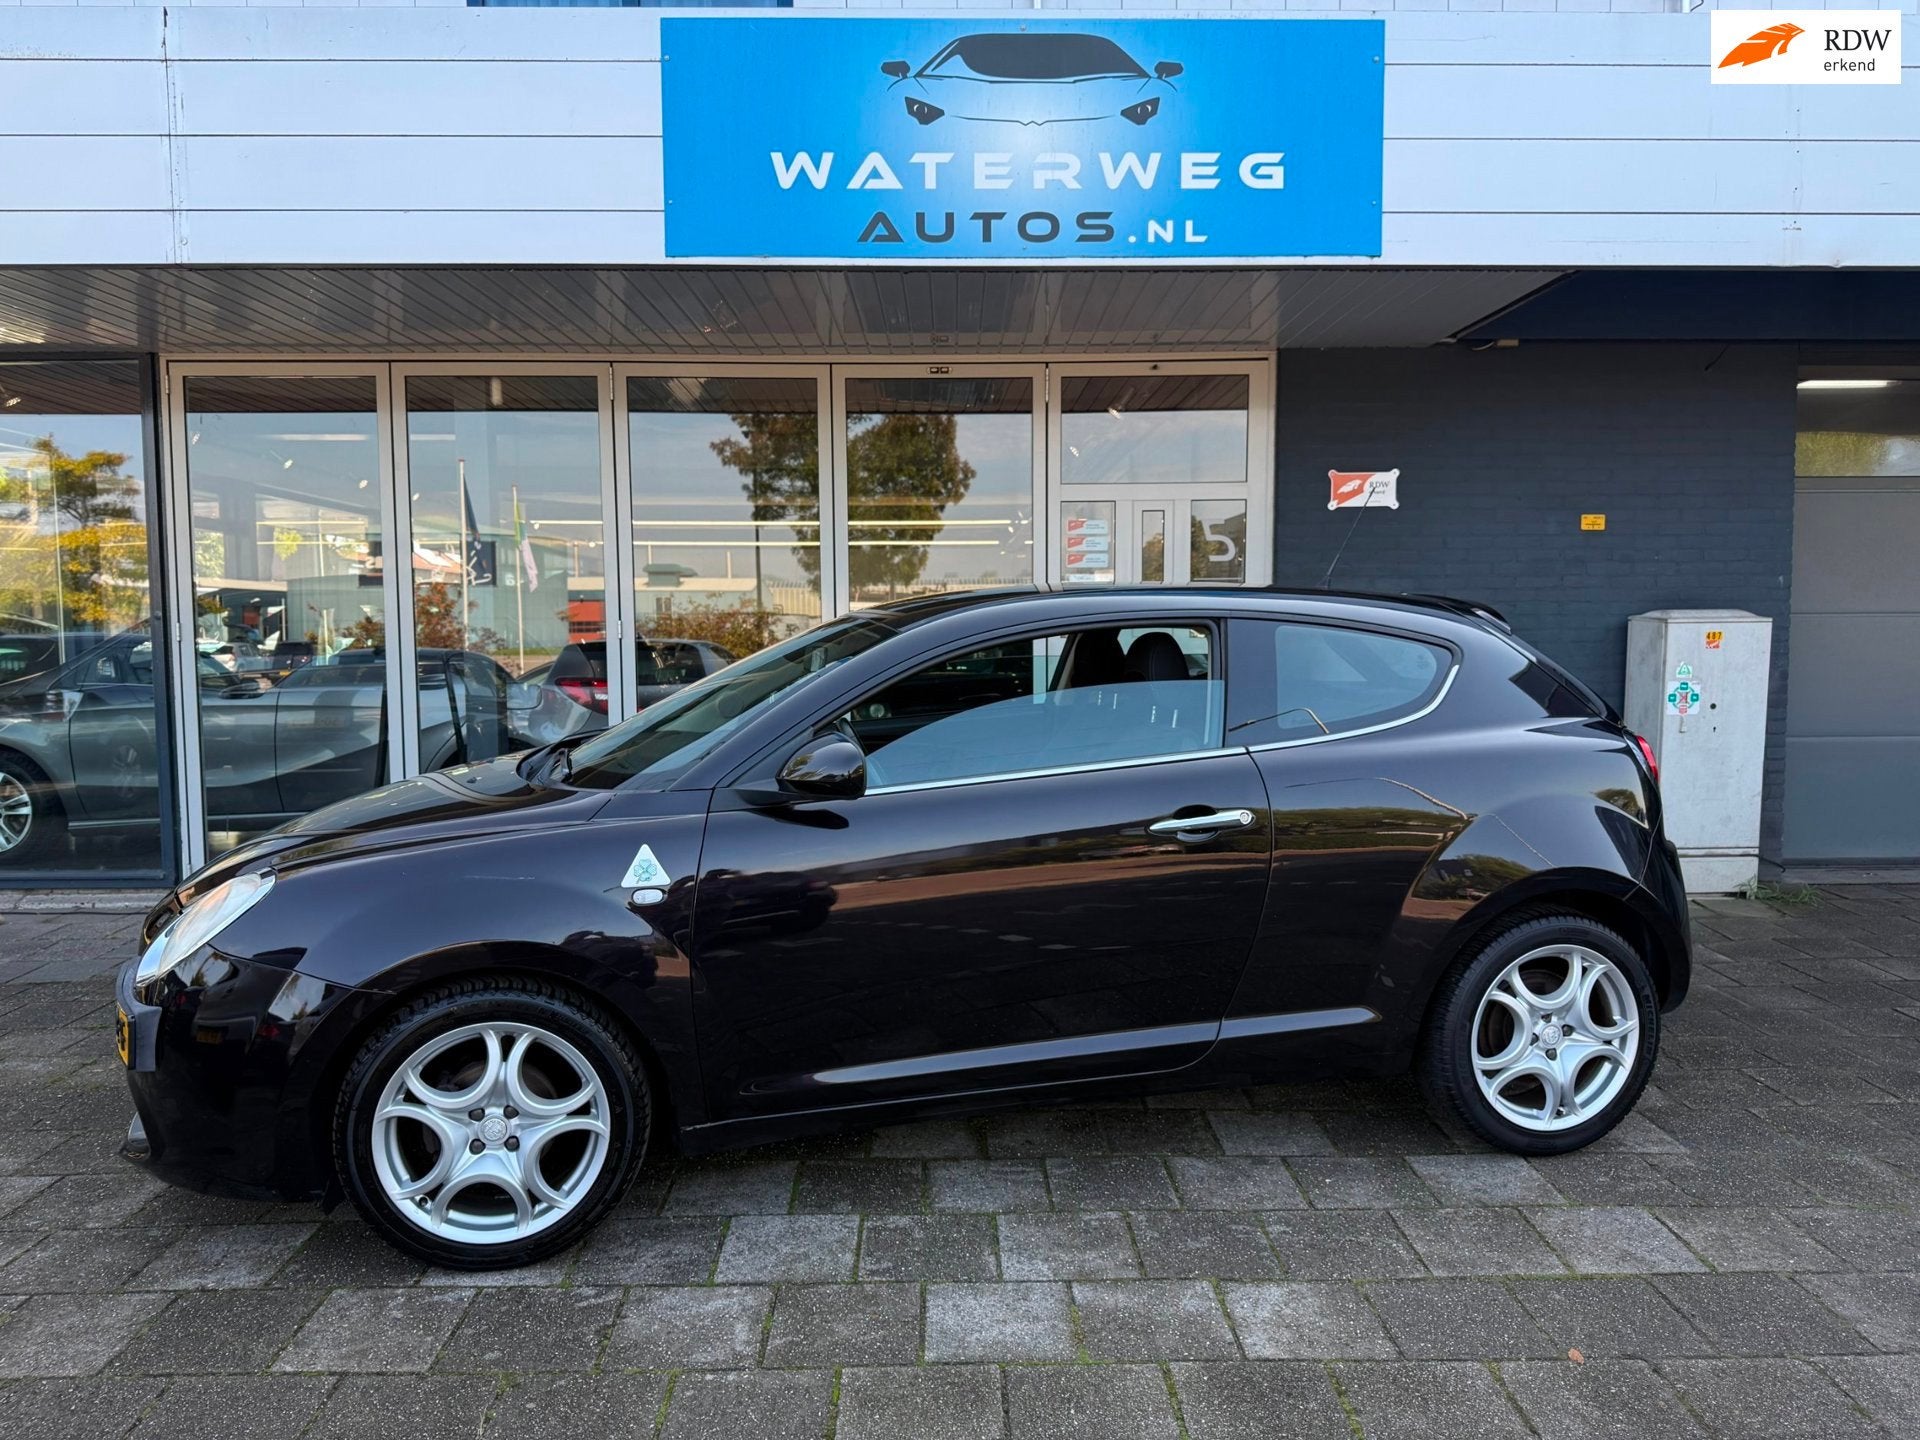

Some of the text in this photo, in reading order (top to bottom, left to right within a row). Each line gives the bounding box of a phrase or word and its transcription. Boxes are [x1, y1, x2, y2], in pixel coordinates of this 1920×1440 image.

[770, 151, 1285, 190] WATERWEG
[858, 211, 1209, 243] AUTOS.NL
[1201, 518, 1236, 562] 5
[1642, 994, 1655, 1055] MICHELIN
